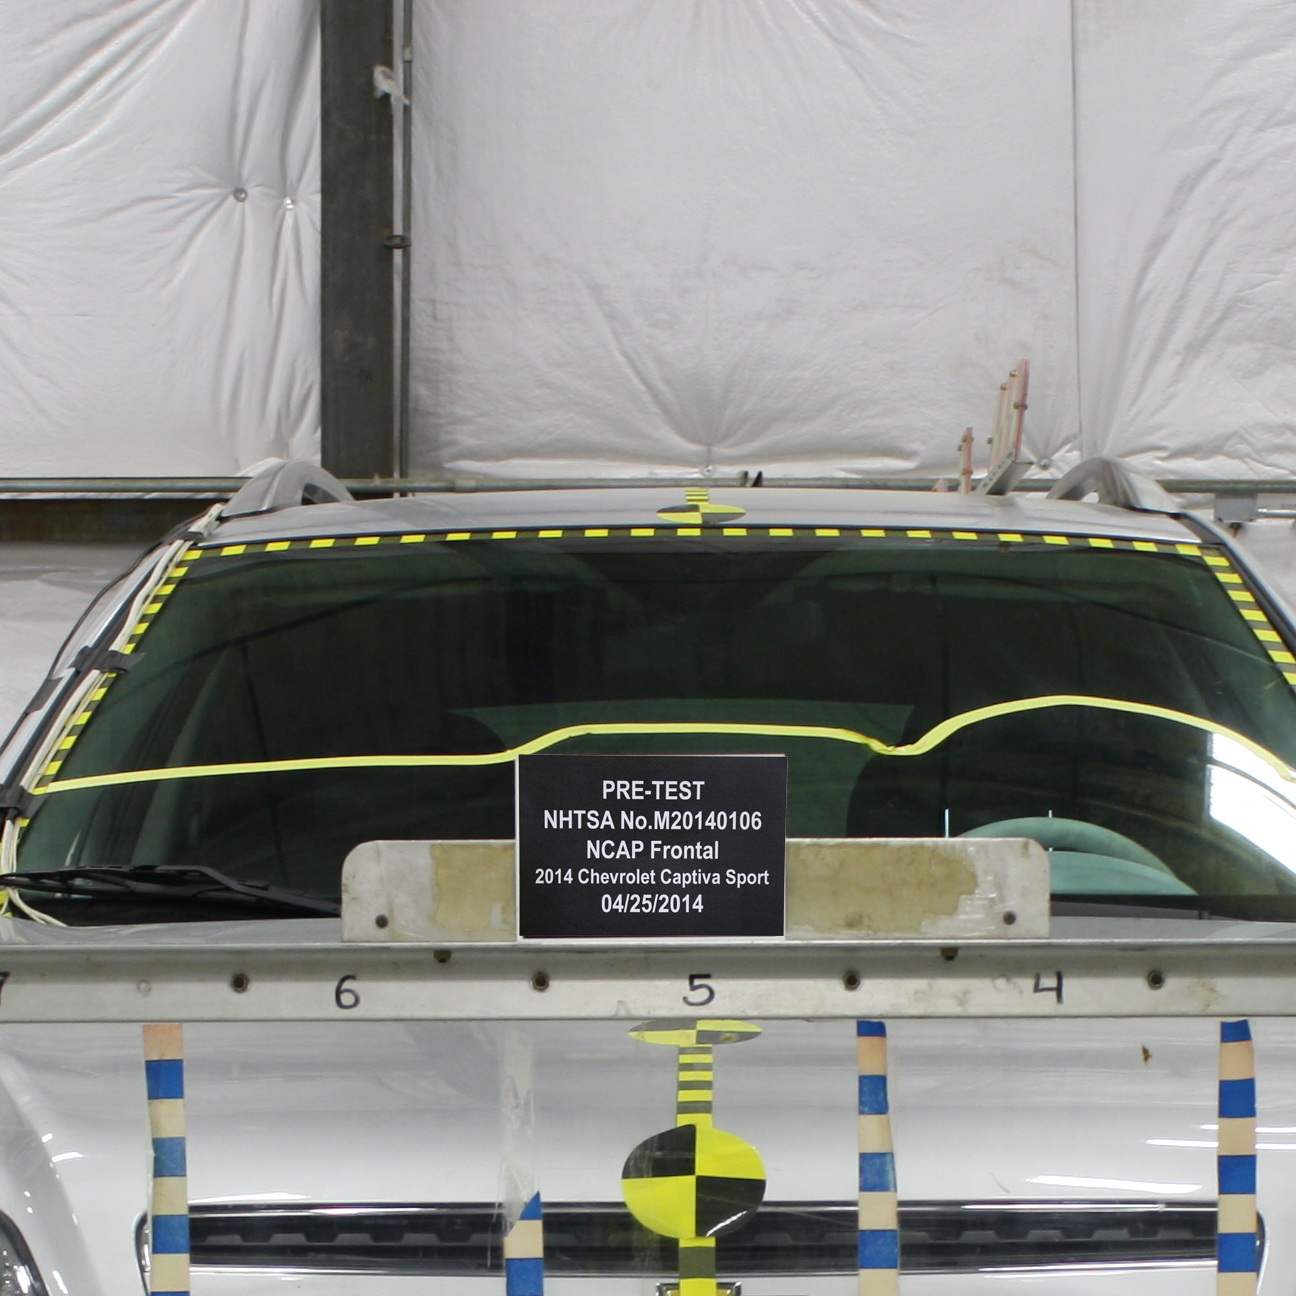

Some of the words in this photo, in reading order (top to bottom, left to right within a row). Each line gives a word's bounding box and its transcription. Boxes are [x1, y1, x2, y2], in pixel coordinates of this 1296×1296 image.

[602, 780, 705, 800] PRE-TEST
[544, 810, 615, 830] NHTSA
[621, 810, 762, 830] No.M20140106
[586, 840, 645, 859] NCAP
[650, 840, 719, 860] Frontal
[535, 868, 573, 884] 2014
[578, 868, 656, 885] Chevrolet
[660, 868, 721, 888] Captiva
[725, 869, 770, 888] Sport
[601, 894, 704, 913] 04/25/2014
[334, 973, 361, 1010] 6
[682, 973, 716, 1007] 5
[1032, 970, 1065, 1004] 4
